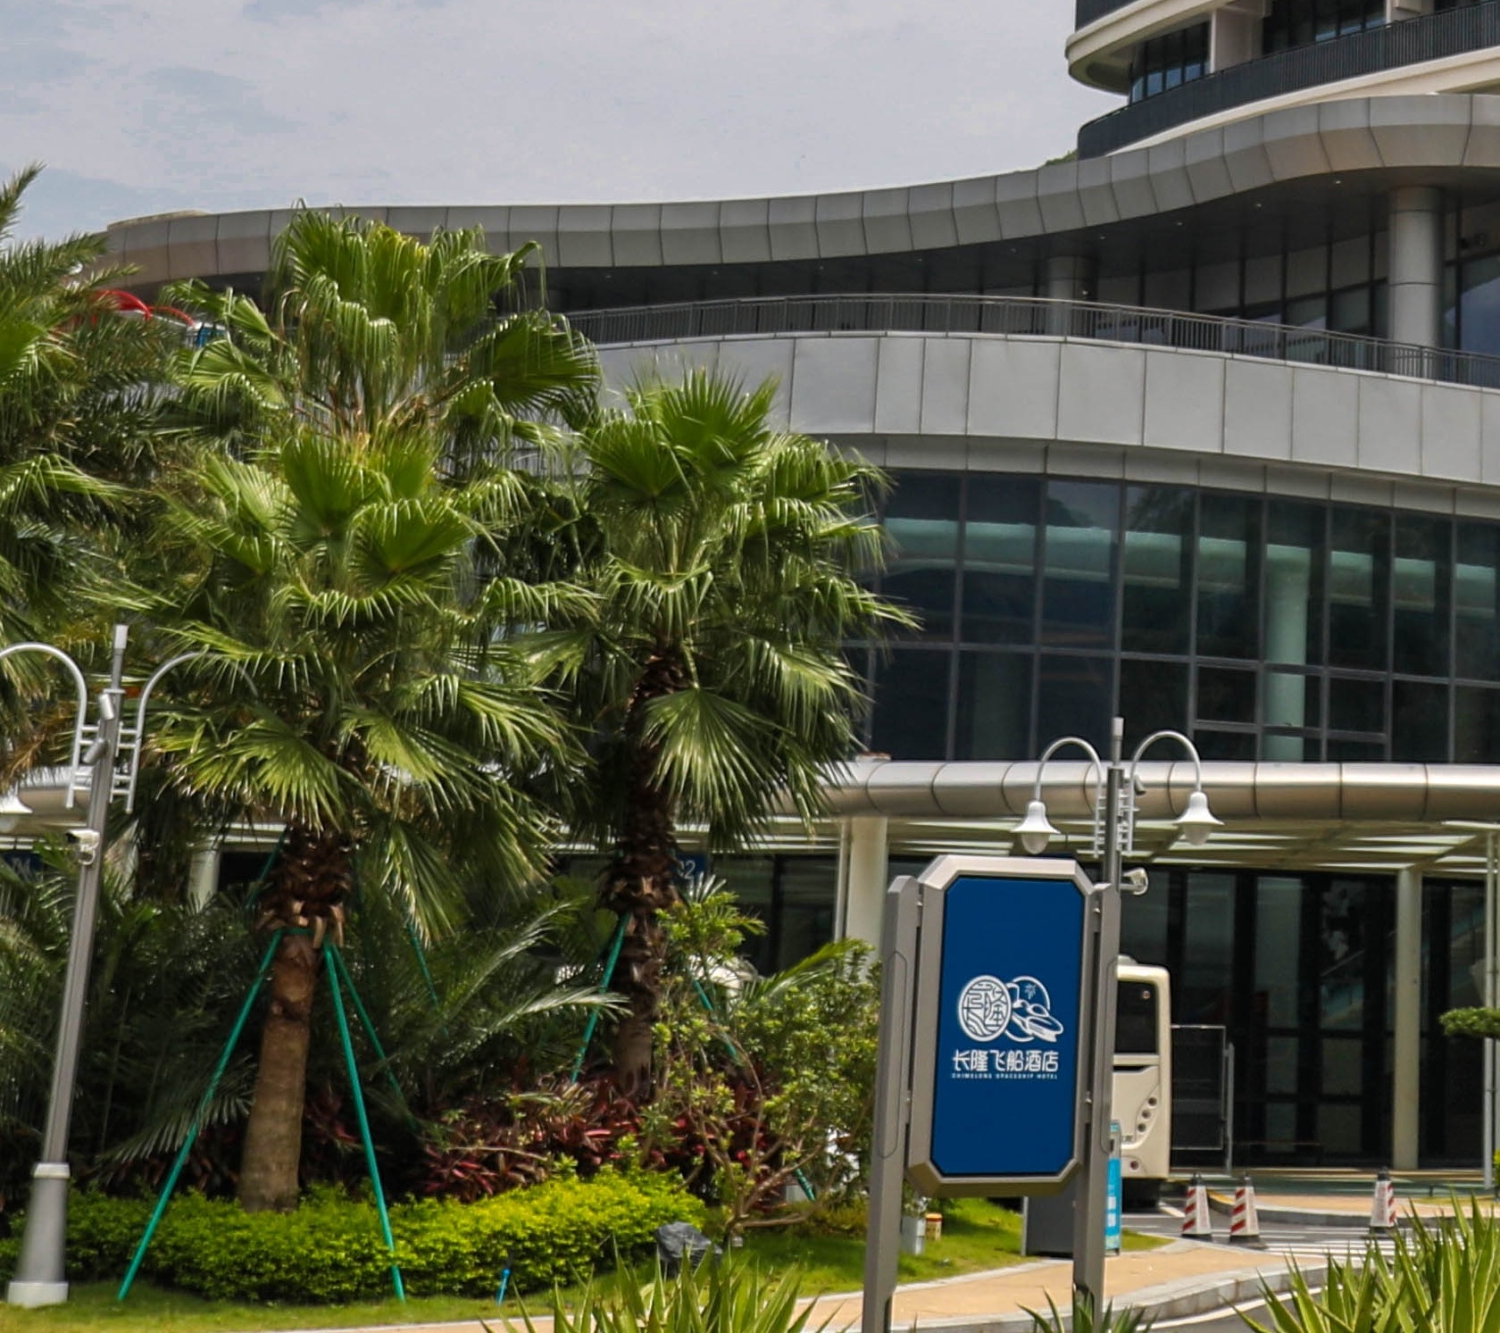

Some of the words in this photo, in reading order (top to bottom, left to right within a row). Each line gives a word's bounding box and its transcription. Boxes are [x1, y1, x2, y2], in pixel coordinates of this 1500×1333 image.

[952, 1049, 1059, 1072] 长隆飞船酒店
